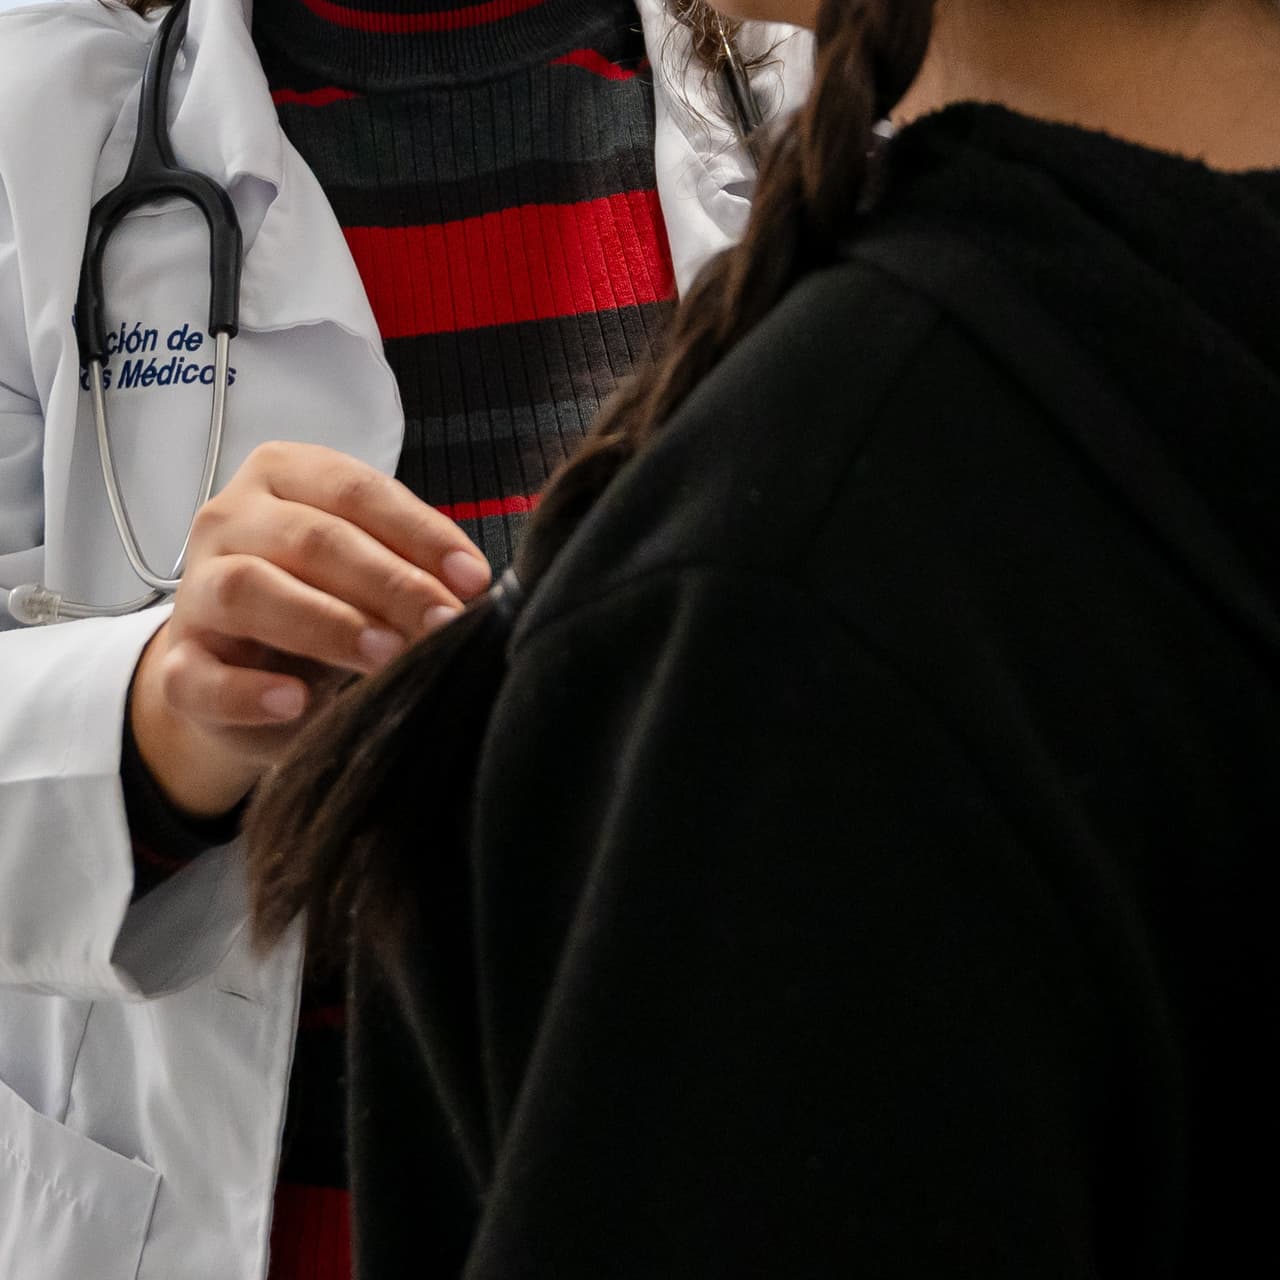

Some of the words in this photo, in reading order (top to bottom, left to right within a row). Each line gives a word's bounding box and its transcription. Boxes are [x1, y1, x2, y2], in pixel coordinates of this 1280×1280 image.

[105, 321, 159, 356] ción
[166, 323, 204, 353] de
[116, 355, 237, 390] Médicos
